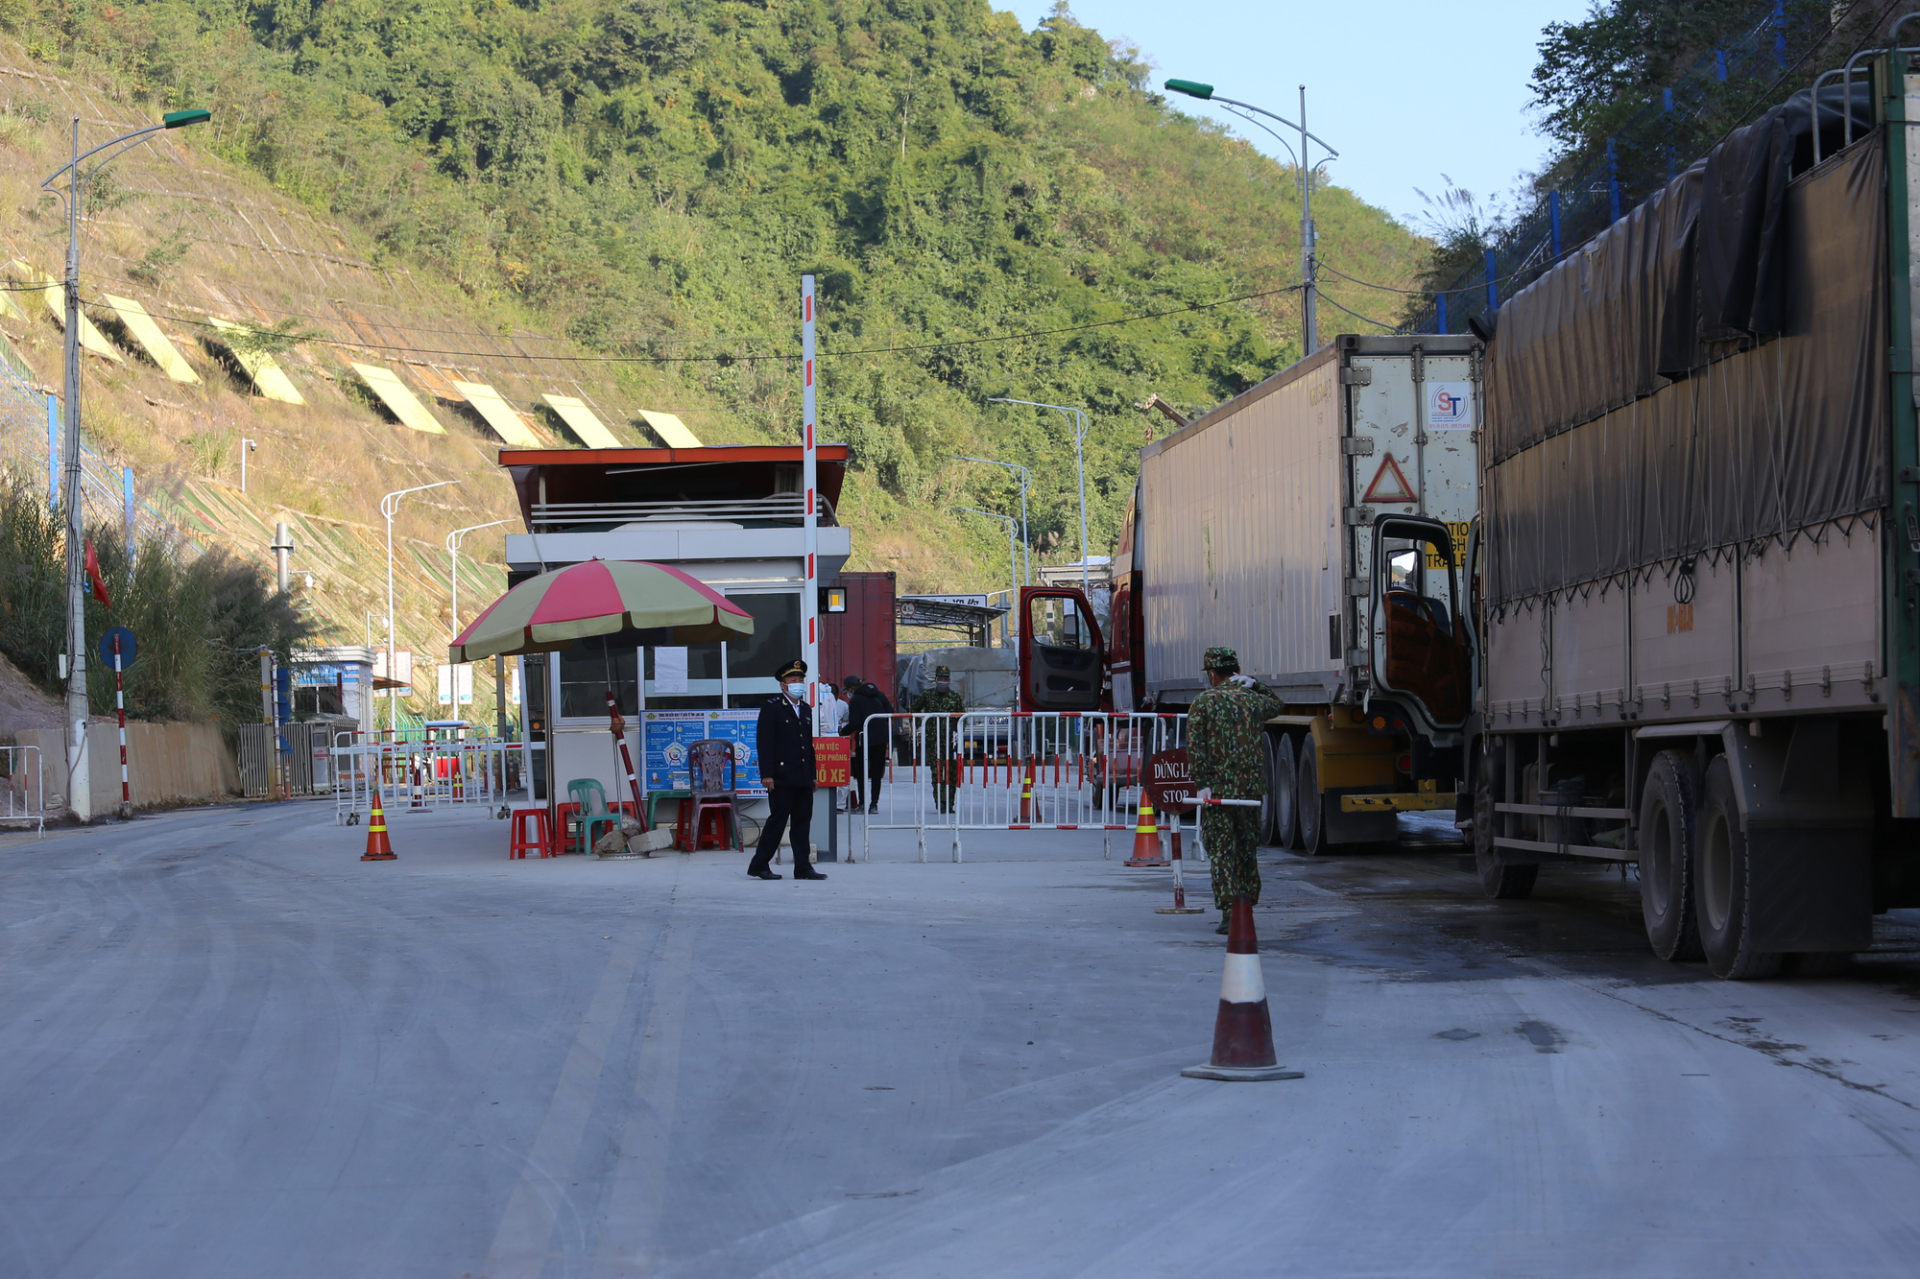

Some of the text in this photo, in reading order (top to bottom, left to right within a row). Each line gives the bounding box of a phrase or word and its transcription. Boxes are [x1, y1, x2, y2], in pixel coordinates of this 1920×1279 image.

[1437, 392, 1461, 416] ST
[1451, 538, 1466, 552] GH
[826, 742, 840, 751] VIỆC
[815, 752, 848, 761] IÊN PHÒNG
[816, 763, 846, 783] Ỗ XE
[1154, 759, 1180, 779] DỪNG
[1163, 790, 1189, 803] STOP
